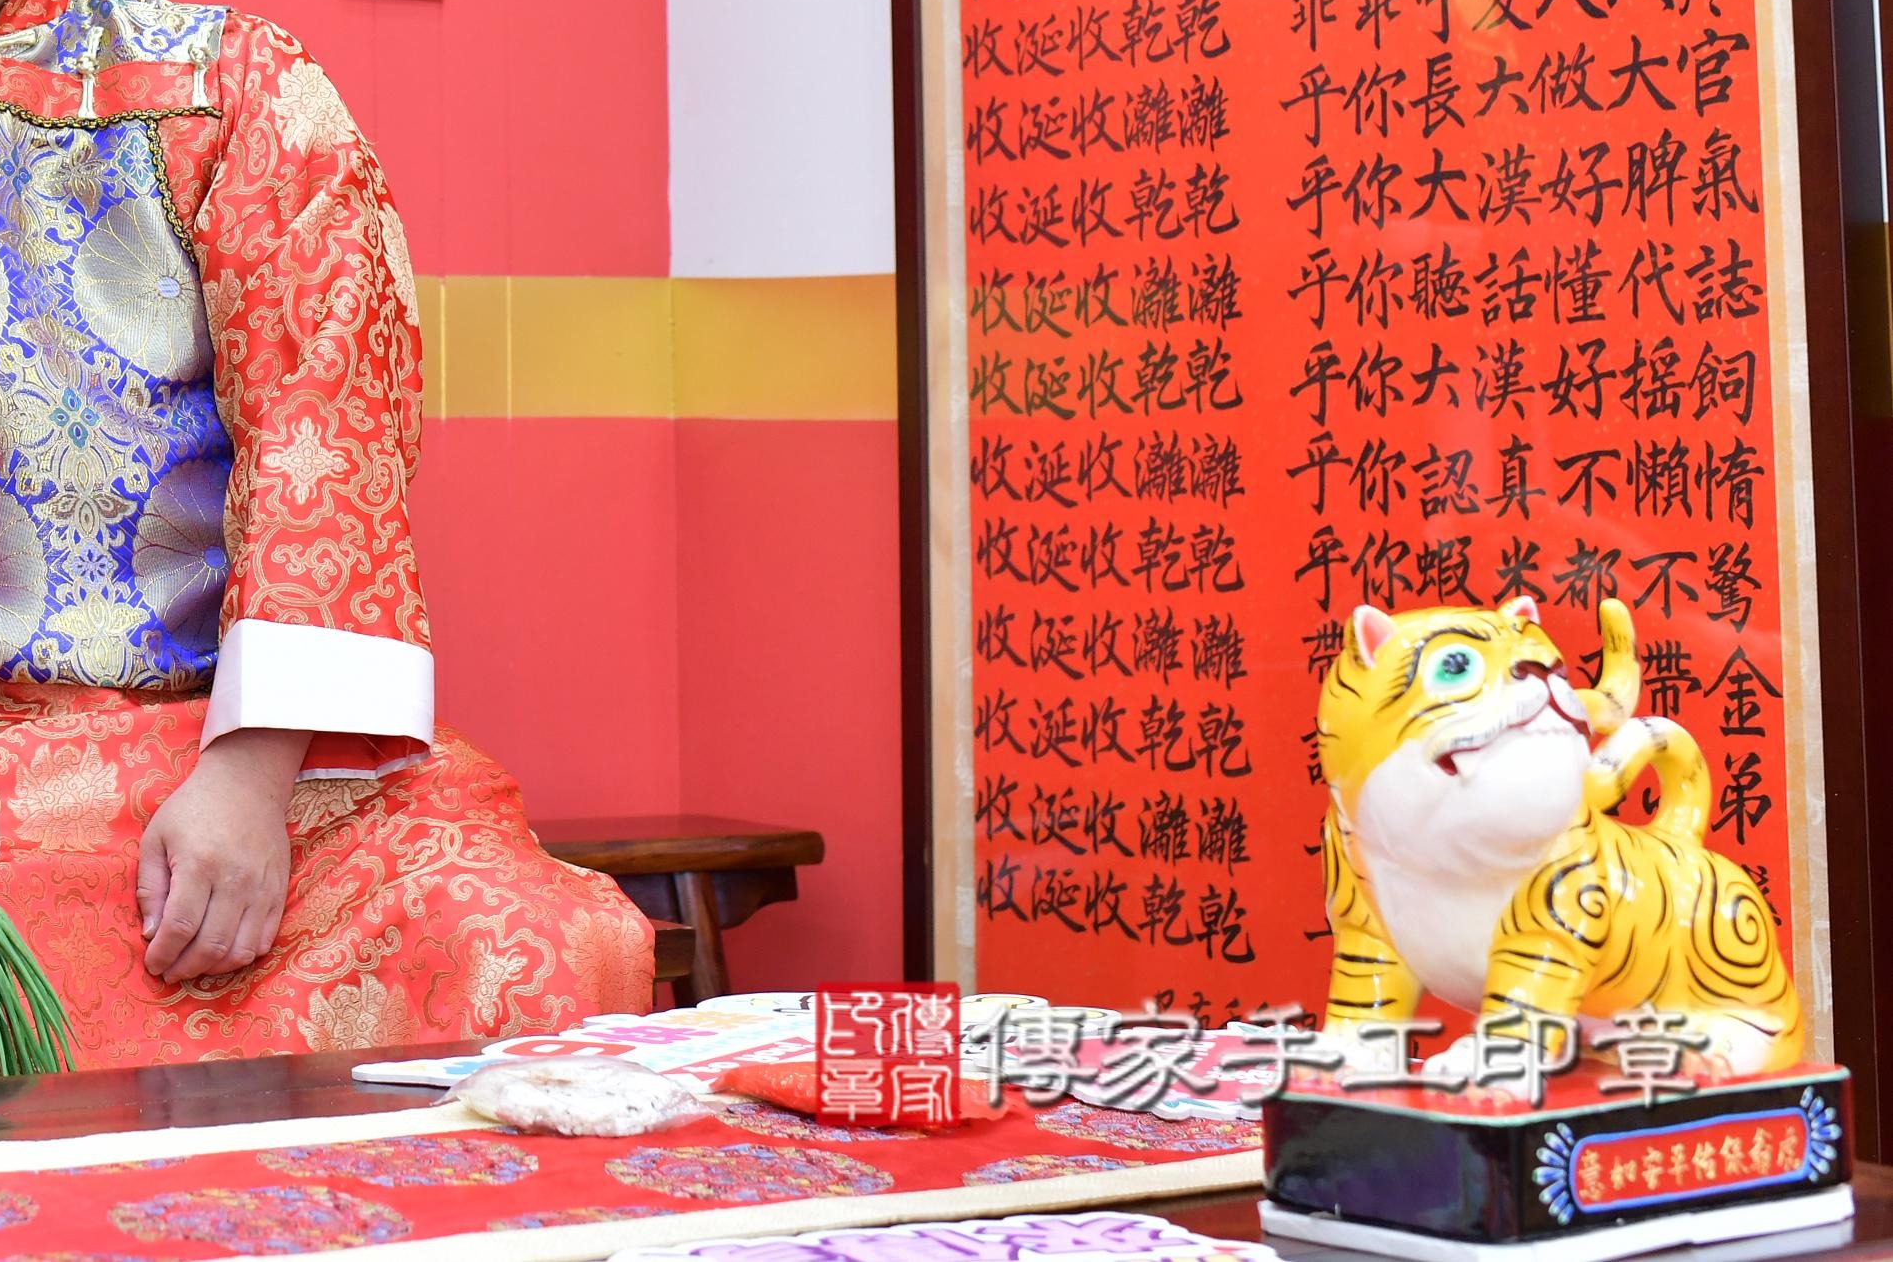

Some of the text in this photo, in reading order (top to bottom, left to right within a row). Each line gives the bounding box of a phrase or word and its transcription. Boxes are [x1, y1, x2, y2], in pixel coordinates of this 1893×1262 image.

[1279, 28, 1749, 149] 乎你長大做大官
[1286, 127, 1760, 239] 乎你大漢好脾氣
[1287, 238, 1764, 331] 乎你聽話懂代誌
